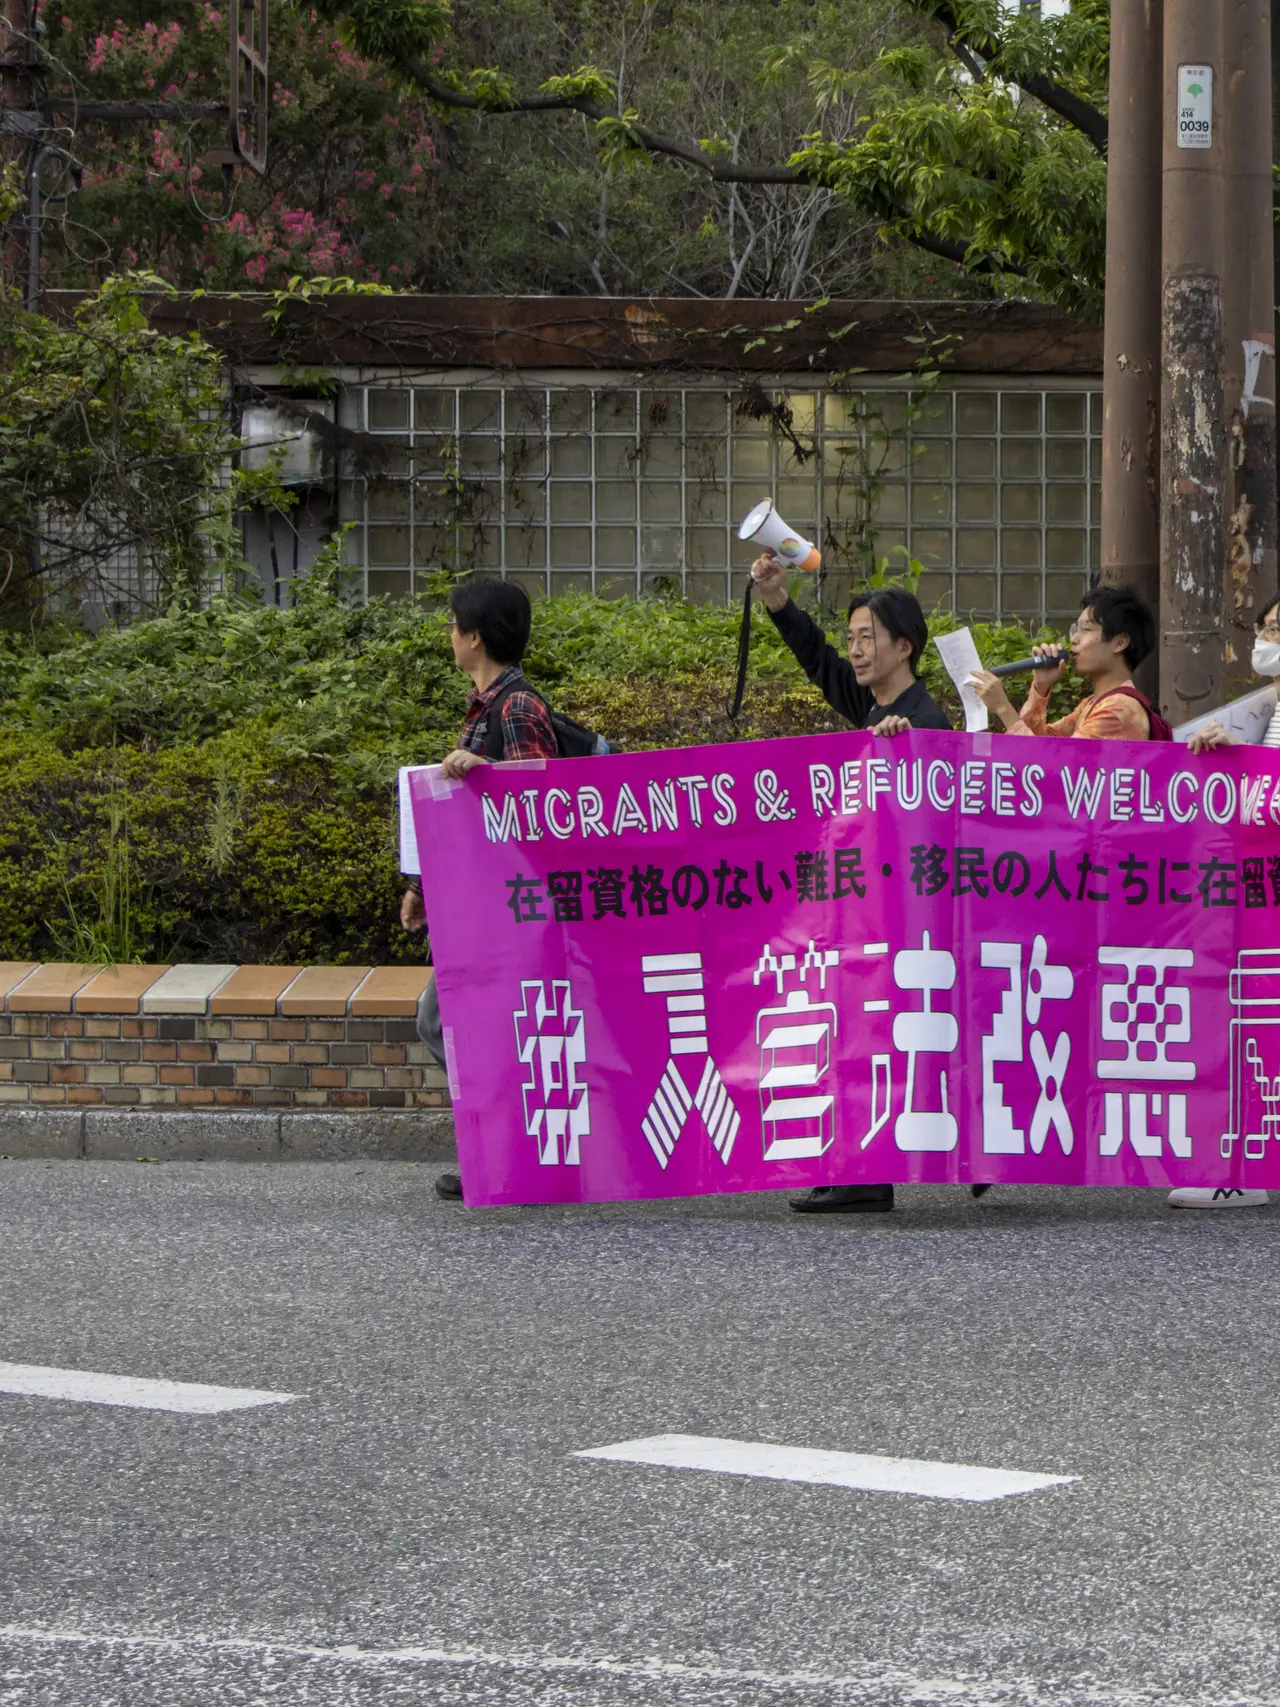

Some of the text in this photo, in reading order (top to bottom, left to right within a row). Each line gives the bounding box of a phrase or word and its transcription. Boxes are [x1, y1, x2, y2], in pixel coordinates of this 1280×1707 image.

[1181, 111, 1194, 119] 414
[1180, 121, 1209, 132] 0039
[481, 772, 738, 843] MIGRANTS
[753, 768, 796, 823] &
[808, 757, 1045, 818] REFUGEES
